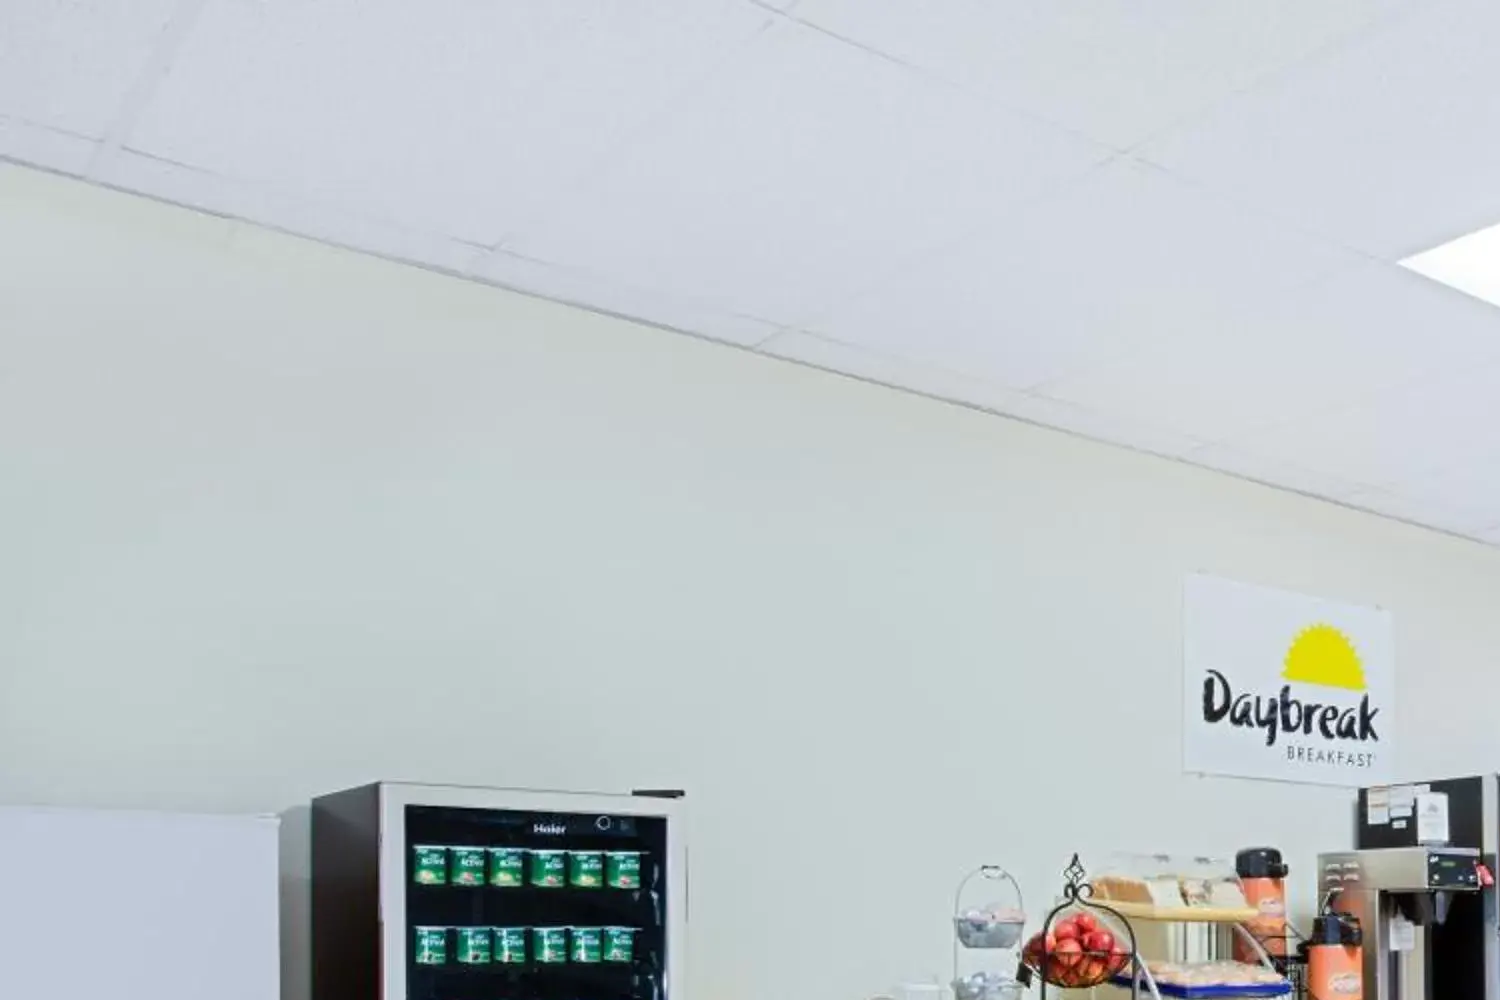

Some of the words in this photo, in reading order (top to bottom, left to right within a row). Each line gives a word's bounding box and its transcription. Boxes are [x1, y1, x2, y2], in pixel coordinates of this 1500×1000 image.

[1202, 668, 1379, 747] Daybreak
[1286, 746, 1374, 769] BREAKFAST
[532, 823, 567, 836] Haier
